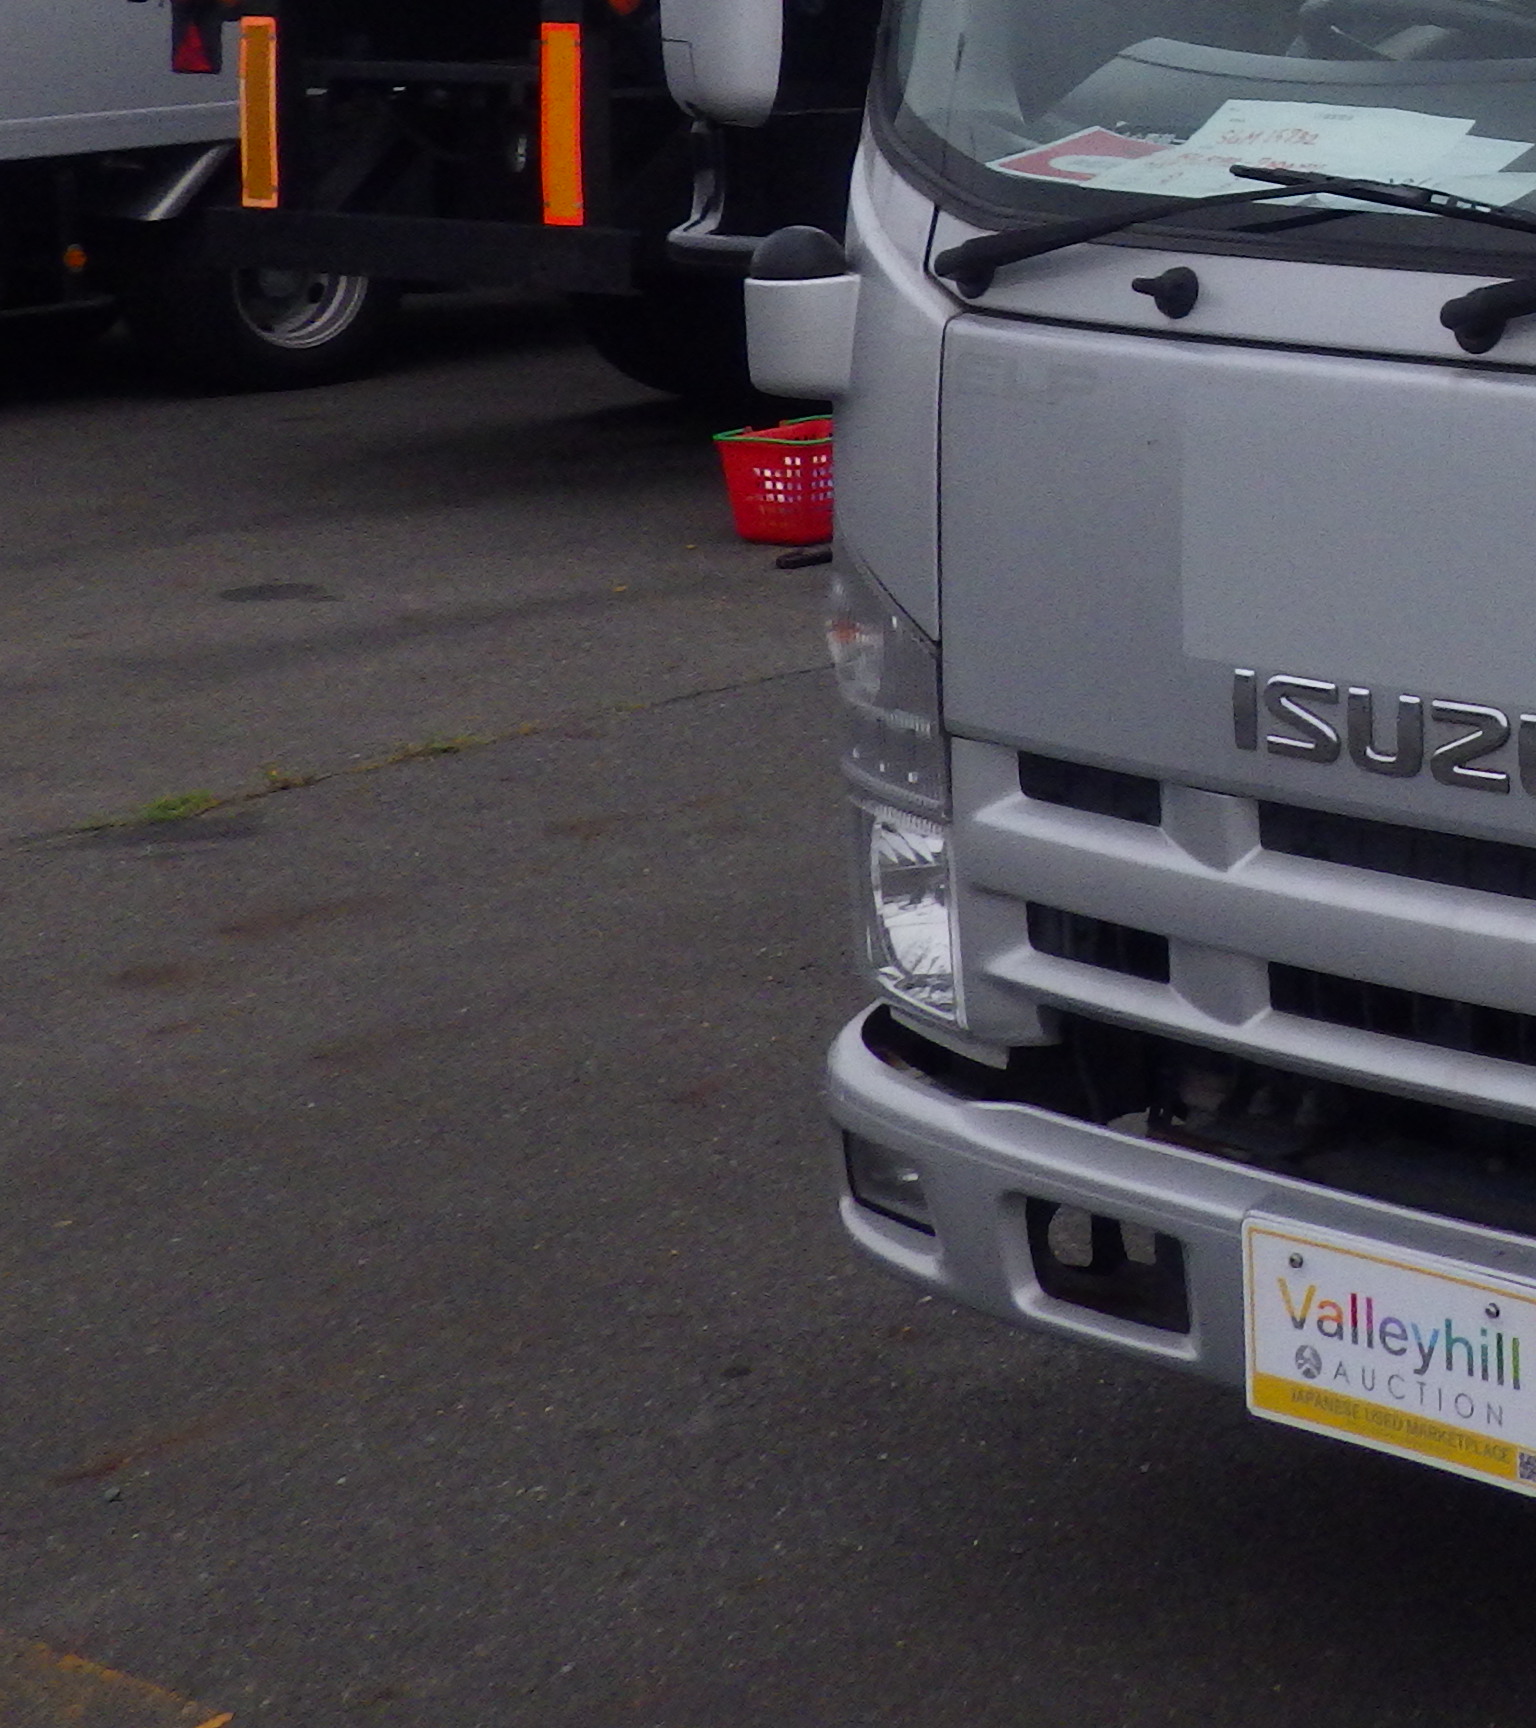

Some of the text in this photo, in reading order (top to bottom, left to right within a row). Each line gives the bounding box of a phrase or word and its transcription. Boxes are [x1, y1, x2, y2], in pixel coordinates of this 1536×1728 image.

[1278, 1277, 1520, 1390] Valleyhill
[1290, 1387, 1360, 1420] JAPANESE
[1332, 1361, 1504, 1427] AUCTION
